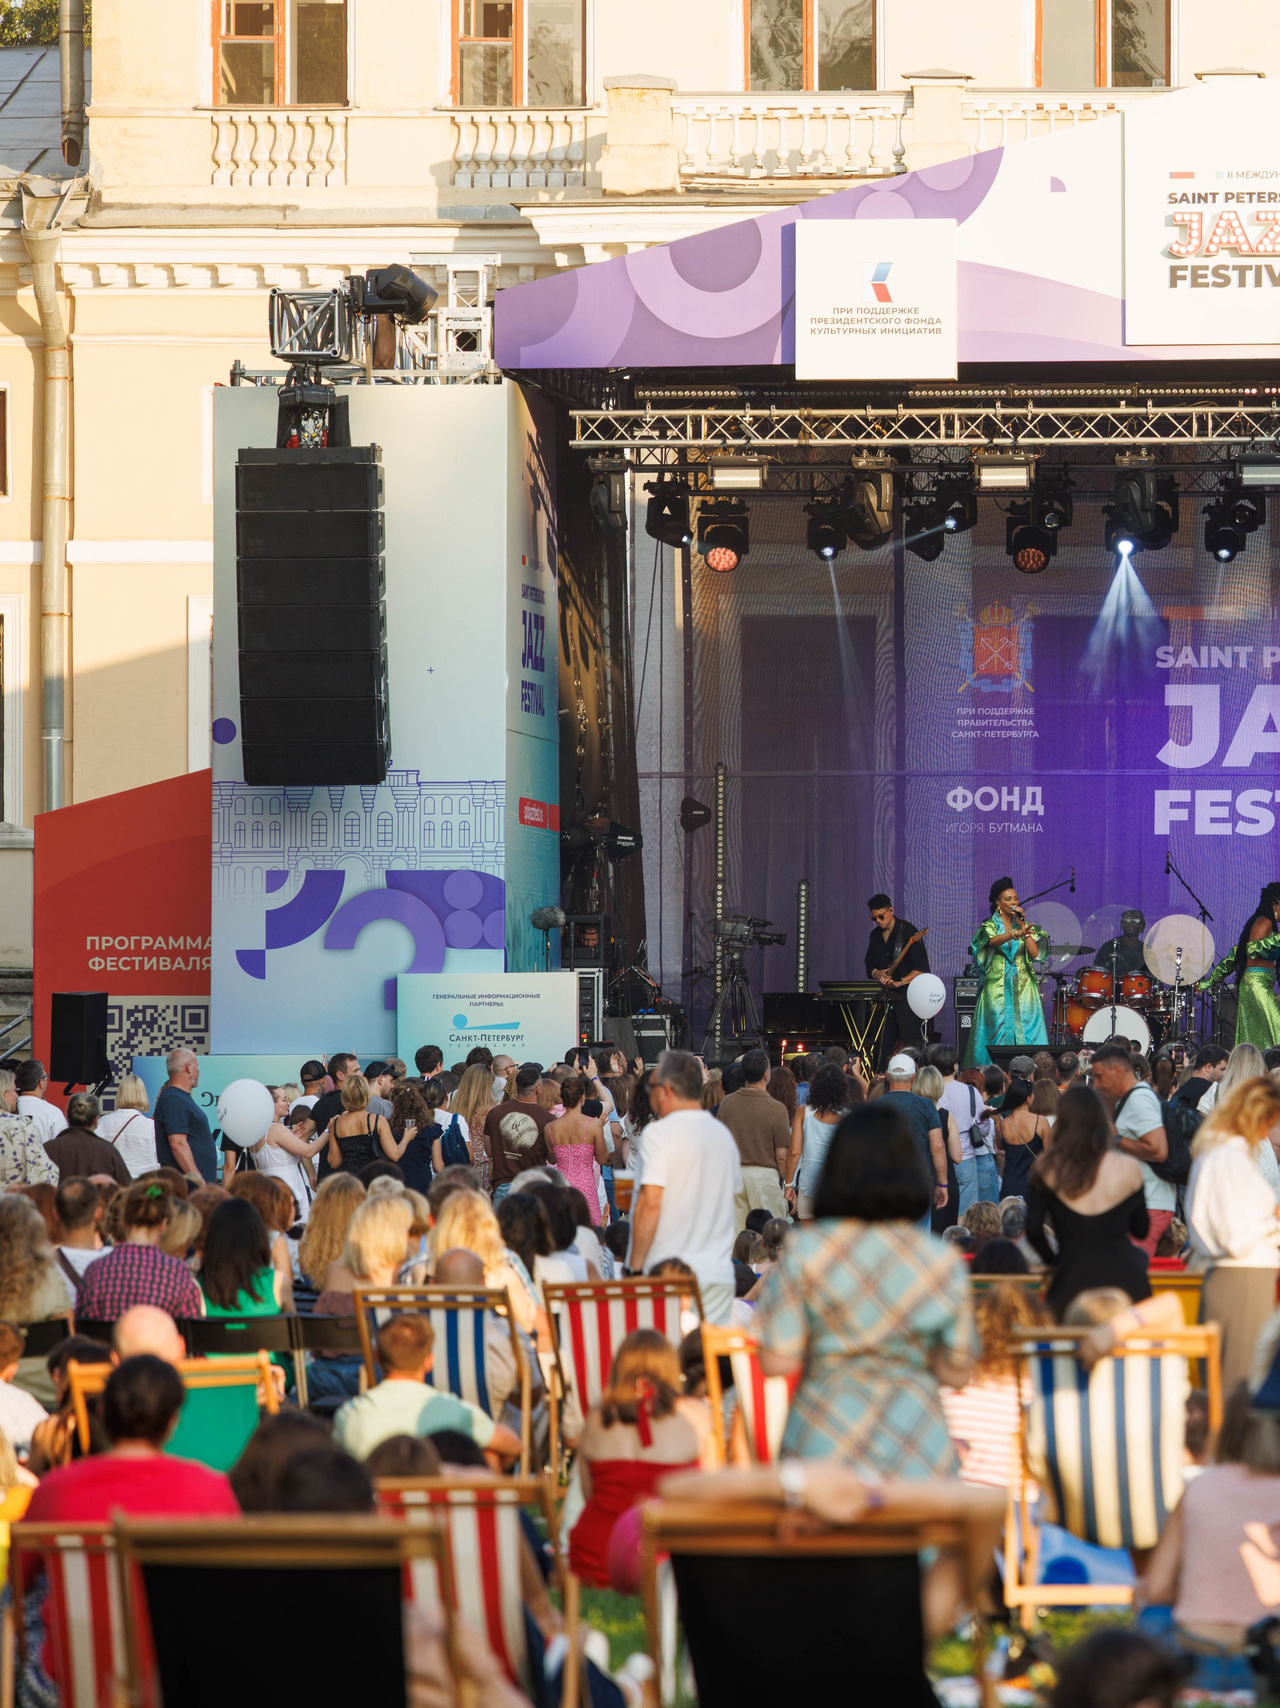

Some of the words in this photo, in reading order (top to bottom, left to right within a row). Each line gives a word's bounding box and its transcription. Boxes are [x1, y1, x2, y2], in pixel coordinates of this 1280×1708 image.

[1168, 192, 1219, 204] SAINT
[833, 307, 853, 315] ПРИ
[856, 307, 920, 316] ПОДДЕРЖКЕ
[810, 317, 902, 326] ПРЕЗИДЕНТСКОГО
[904, 317, 942, 326] ФОНДА
[810, 327, 877, 335] КУЛЬТУРНЫХ
[880, 327, 942, 336] ИНИЦИАТИВ
[521, 609, 545, 673] JAZZ
[1155, 645, 1254, 669] SAINT
[520, 679, 545, 717] FESTIVAL
[978, 708, 1035, 716] ПОДДЕРЖКЕ
[951, 731, 1039, 739] САНКТ-ПЕТЕРБУРГА
[946, 786, 1045, 816] ФОНД
[946, 823, 984, 833] ИГОРЯ
[989, 823, 1044, 833] БУТМАНА
[86, 936, 212, 950] ПРОГРАММА
[88, 956, 212, 971] ФЕСТИВАЛЯ
